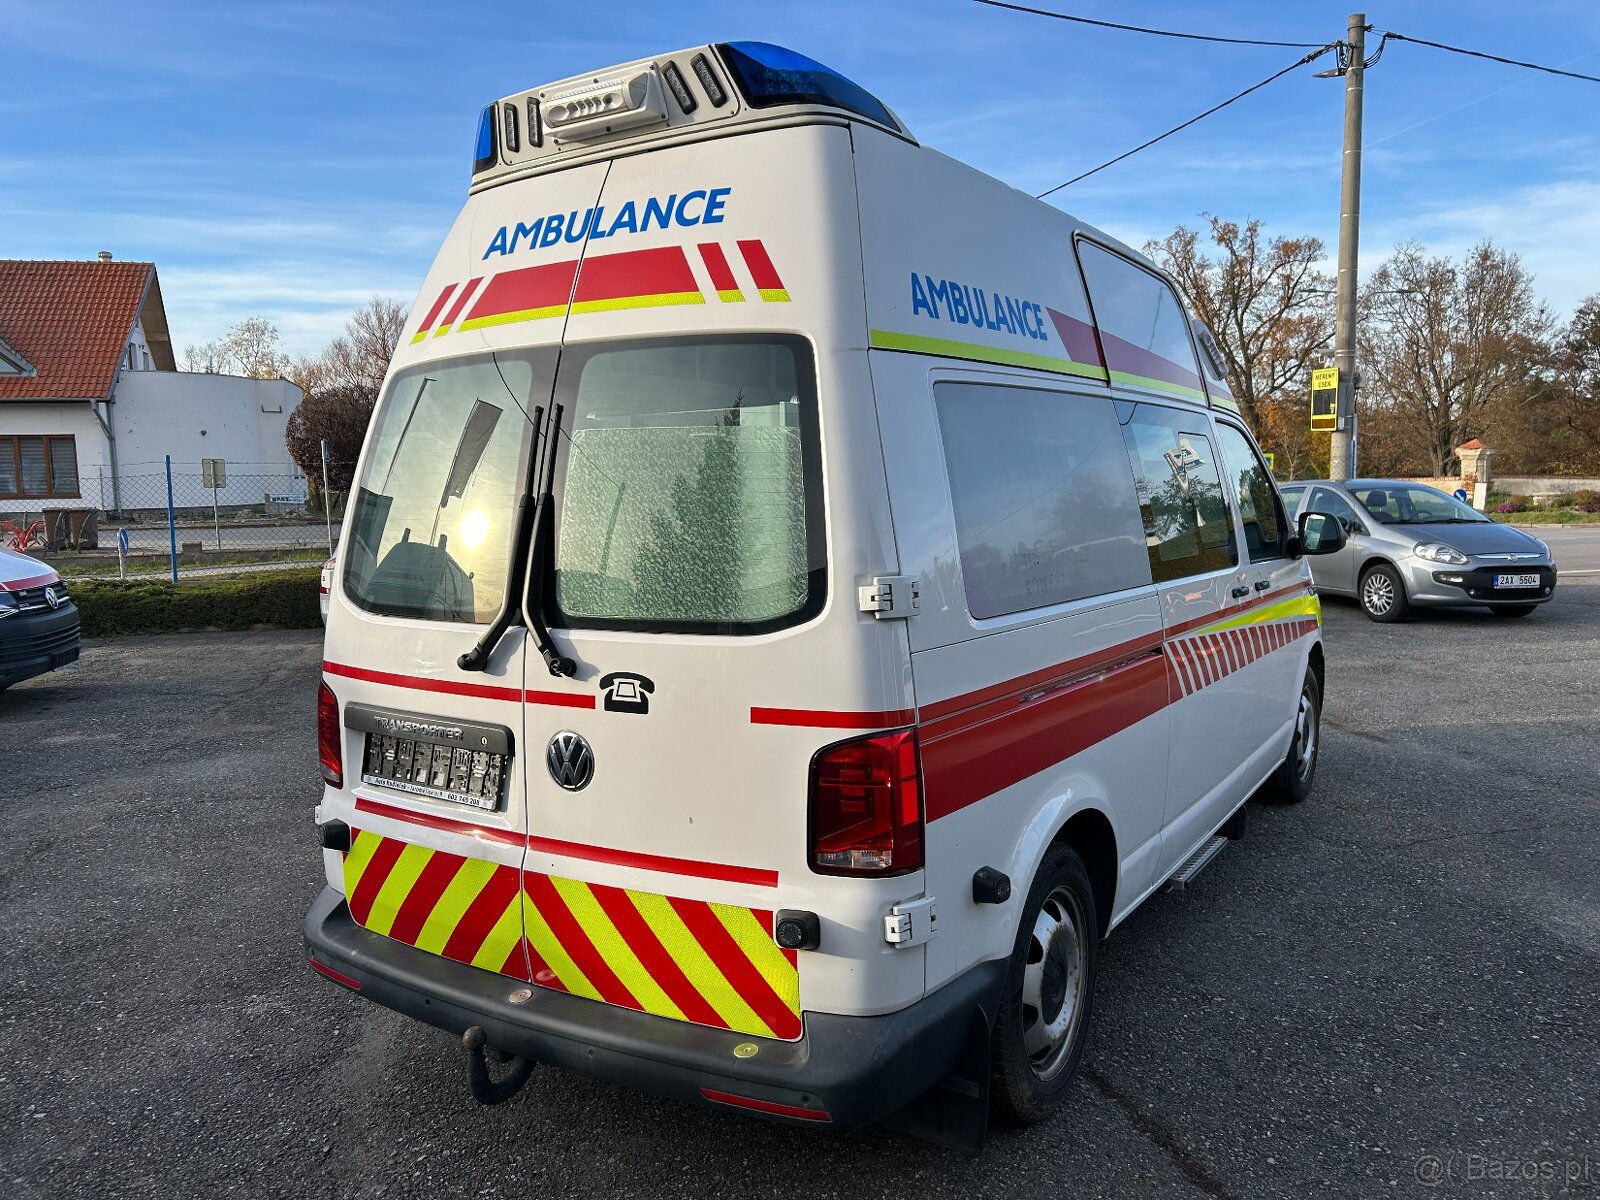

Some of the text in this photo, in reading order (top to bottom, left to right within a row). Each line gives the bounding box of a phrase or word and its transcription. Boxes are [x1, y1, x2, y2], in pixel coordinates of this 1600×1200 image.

[482, 187, 731, 260] AMBULANCE
[911, 272, 1047, 341] AMBULANCE
[1500, 575, 1537, 585] 2AX 5504
[374, 716, 464, 741] TRANSPORTER
[447, 793, 458, 801] 602
